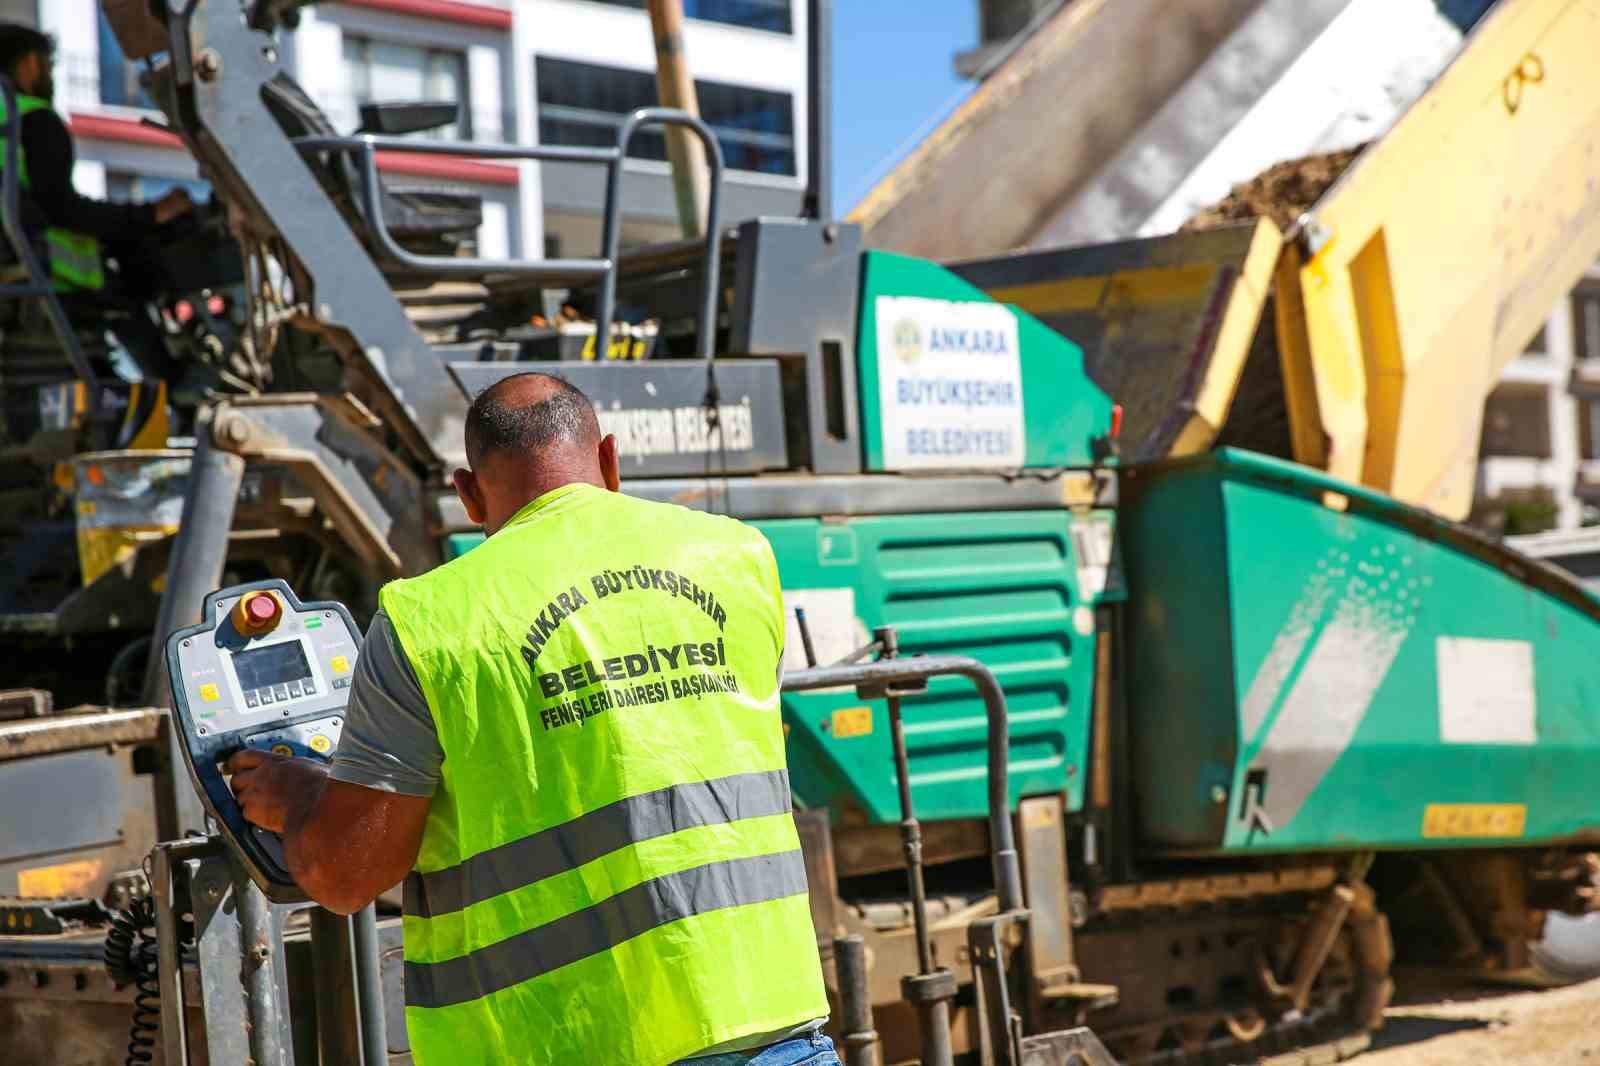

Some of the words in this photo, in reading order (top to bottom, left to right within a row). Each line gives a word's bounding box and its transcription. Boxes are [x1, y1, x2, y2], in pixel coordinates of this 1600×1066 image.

[928, 326, 1009, 355] ANKARA
[896, 374, 1015, 413] BÜYÜKŞEHİR
[906, 425, 1013, 455] BELEDİYESİ
[520, 585, 588, 672] ANKARA
[591, 565, 727, 632] BÜYÜKŞEHİR
[538, 637, 726, 698] BELEDİYESİ
[616, 676, 669, 708] DAİRESİ
